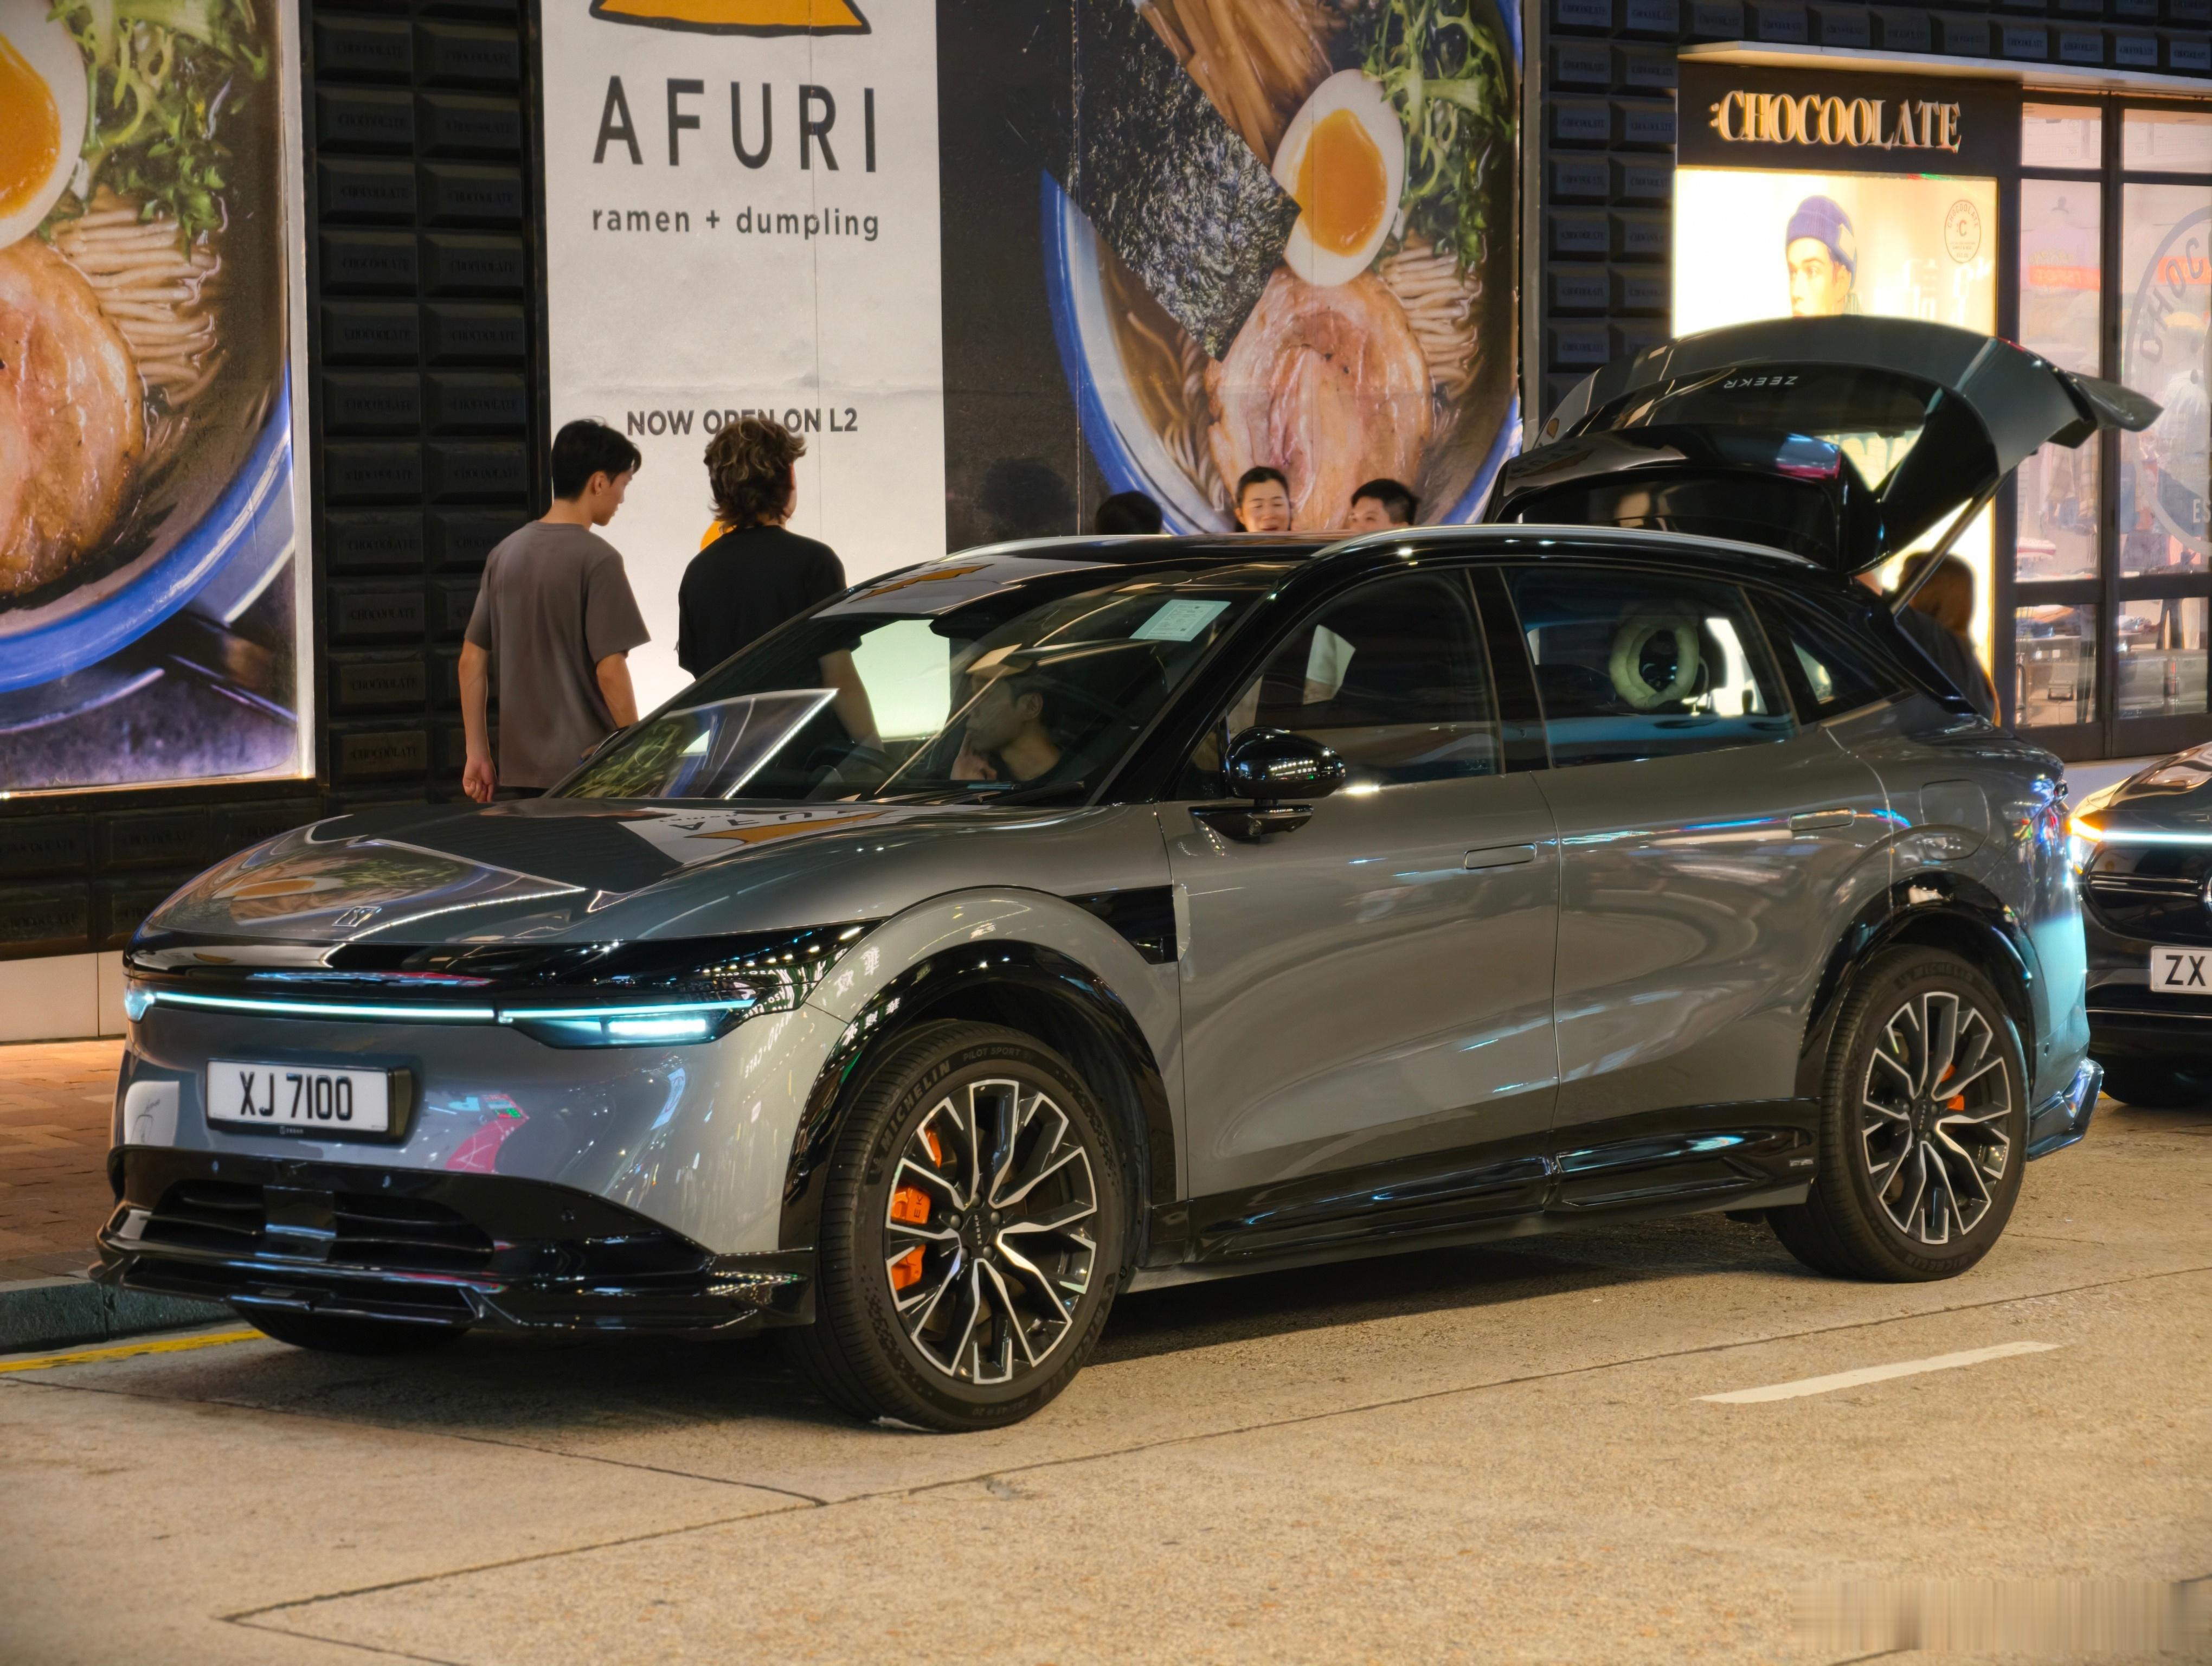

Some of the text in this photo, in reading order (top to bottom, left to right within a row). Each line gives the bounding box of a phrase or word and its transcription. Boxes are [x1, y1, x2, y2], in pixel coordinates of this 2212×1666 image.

[593, 75, 877, 173] AFURI
[592, 206, 879, 242] ramen + dumpling
[2139, 228, 2212, 363] CHOC
[1724, 376, 1799, 389] ZEEKR
[627, 409, 694, 435] NOW
[783, 408, 821, 433] ON
[830, 407, 858, 432] L2
[2165, 954, 2207, 986] ZX
[240, 1072, 352, 1121] XJ 7100
[880, 1060, 950, 1151] MICHELIN
[963, 1048, 988, 1061] PILOT
[991, 1047, 1021, 1055] SPORT
